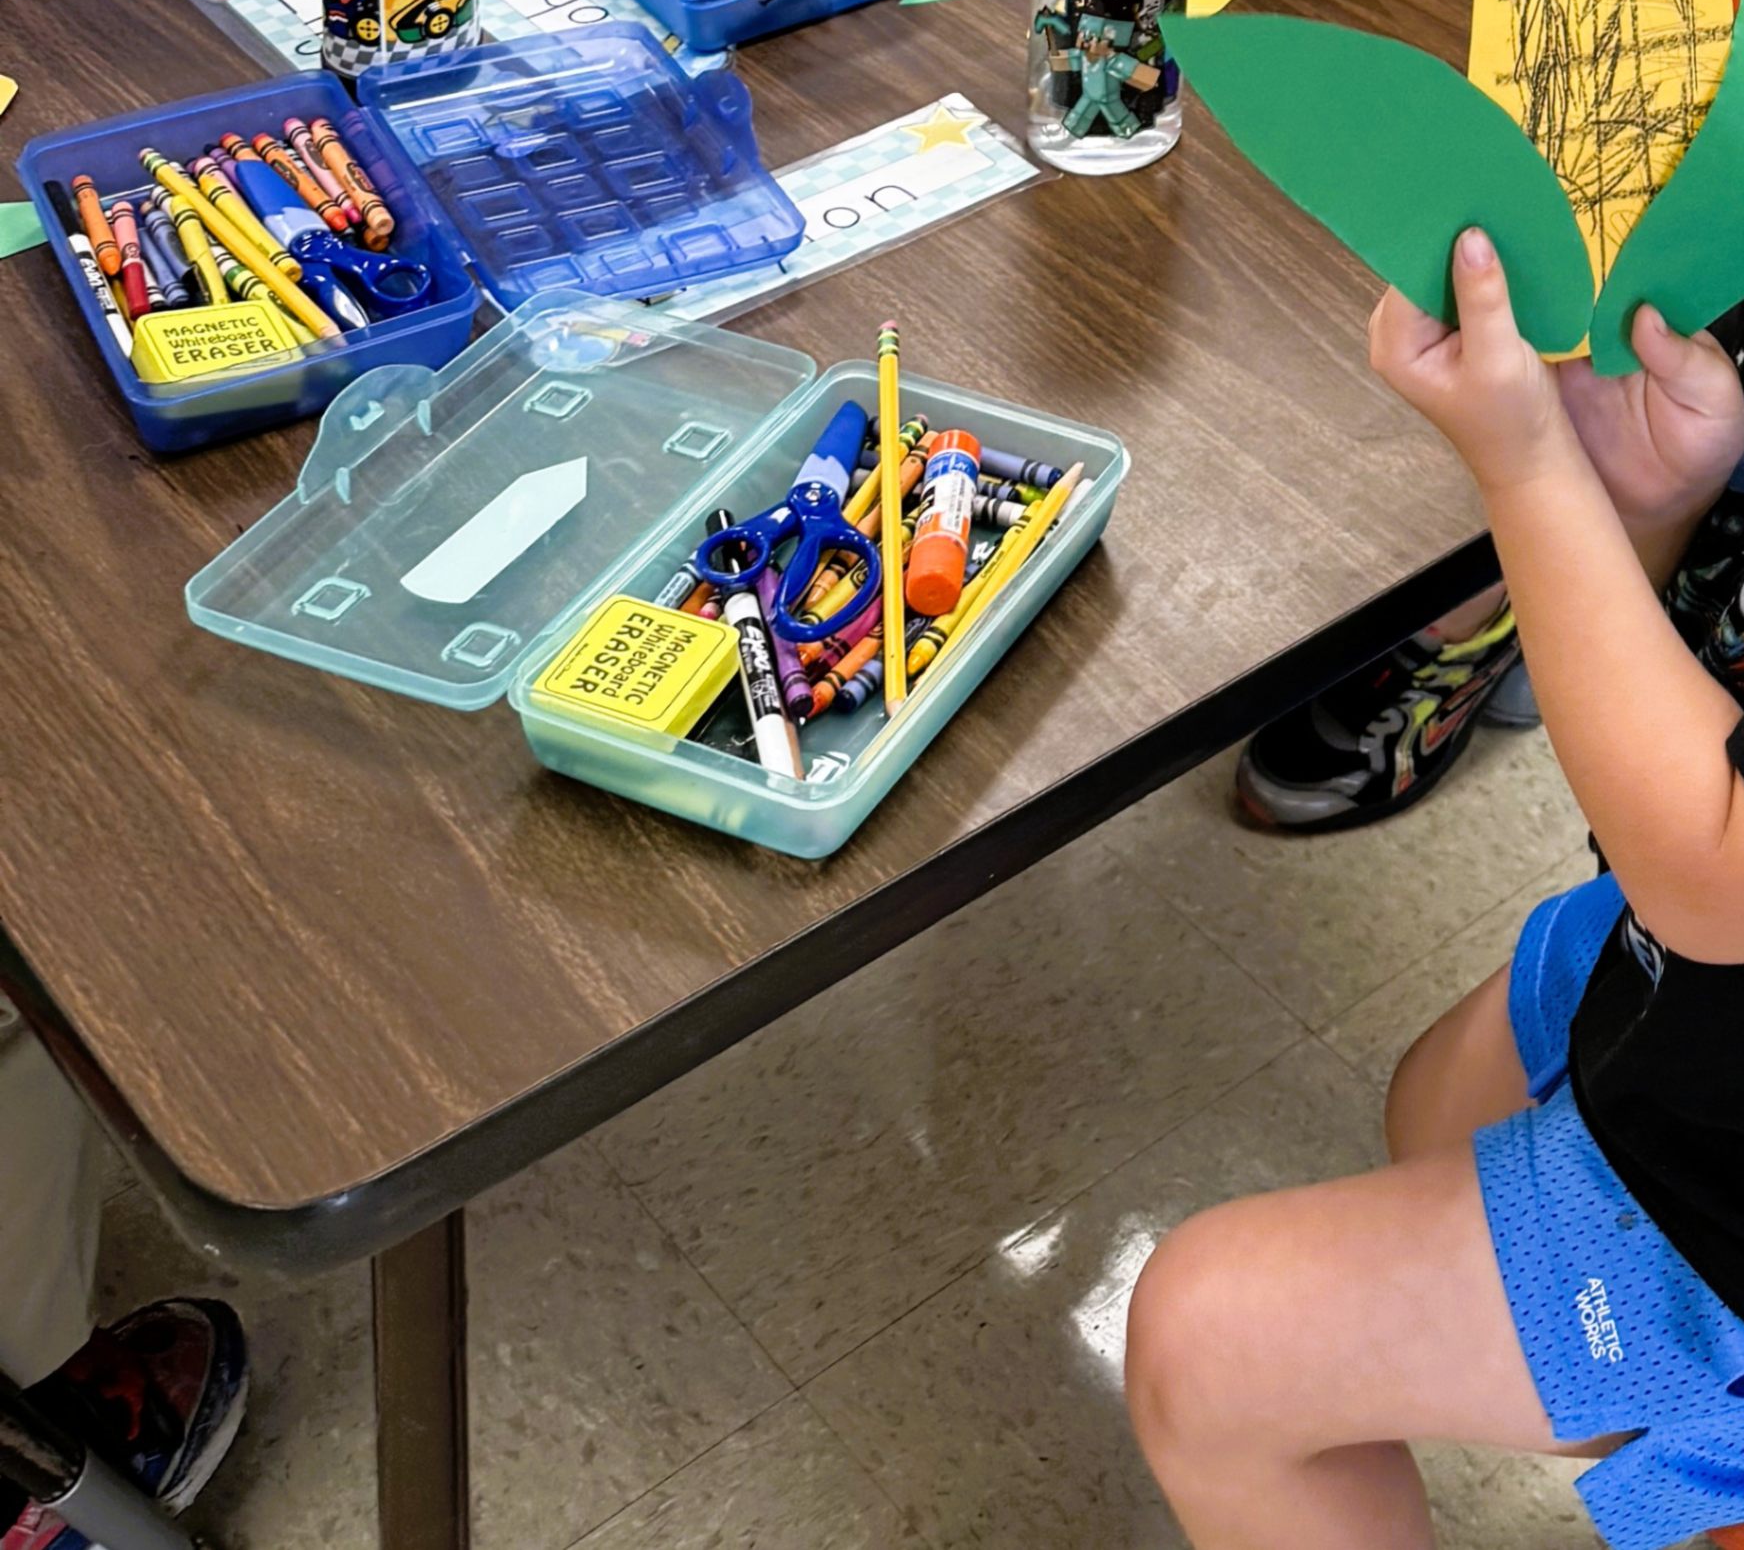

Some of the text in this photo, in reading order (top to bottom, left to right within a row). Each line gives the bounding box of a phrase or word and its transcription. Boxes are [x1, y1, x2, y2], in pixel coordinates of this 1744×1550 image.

[163, 316, 259, 338] MAGNETIC
[169, 328, 266, 349] Whiteboard
[174, 338, 279, 365] ERASER
[569, 612, 655, 694] ERASER
[601, 623, 676, 699] Whiteboard
[624, 629, 698, 706] MAGNETIC
[1575, 1288, 1607, 1360] WORKS
[1587, 1277, 1624, 1363] ATHLETIC
